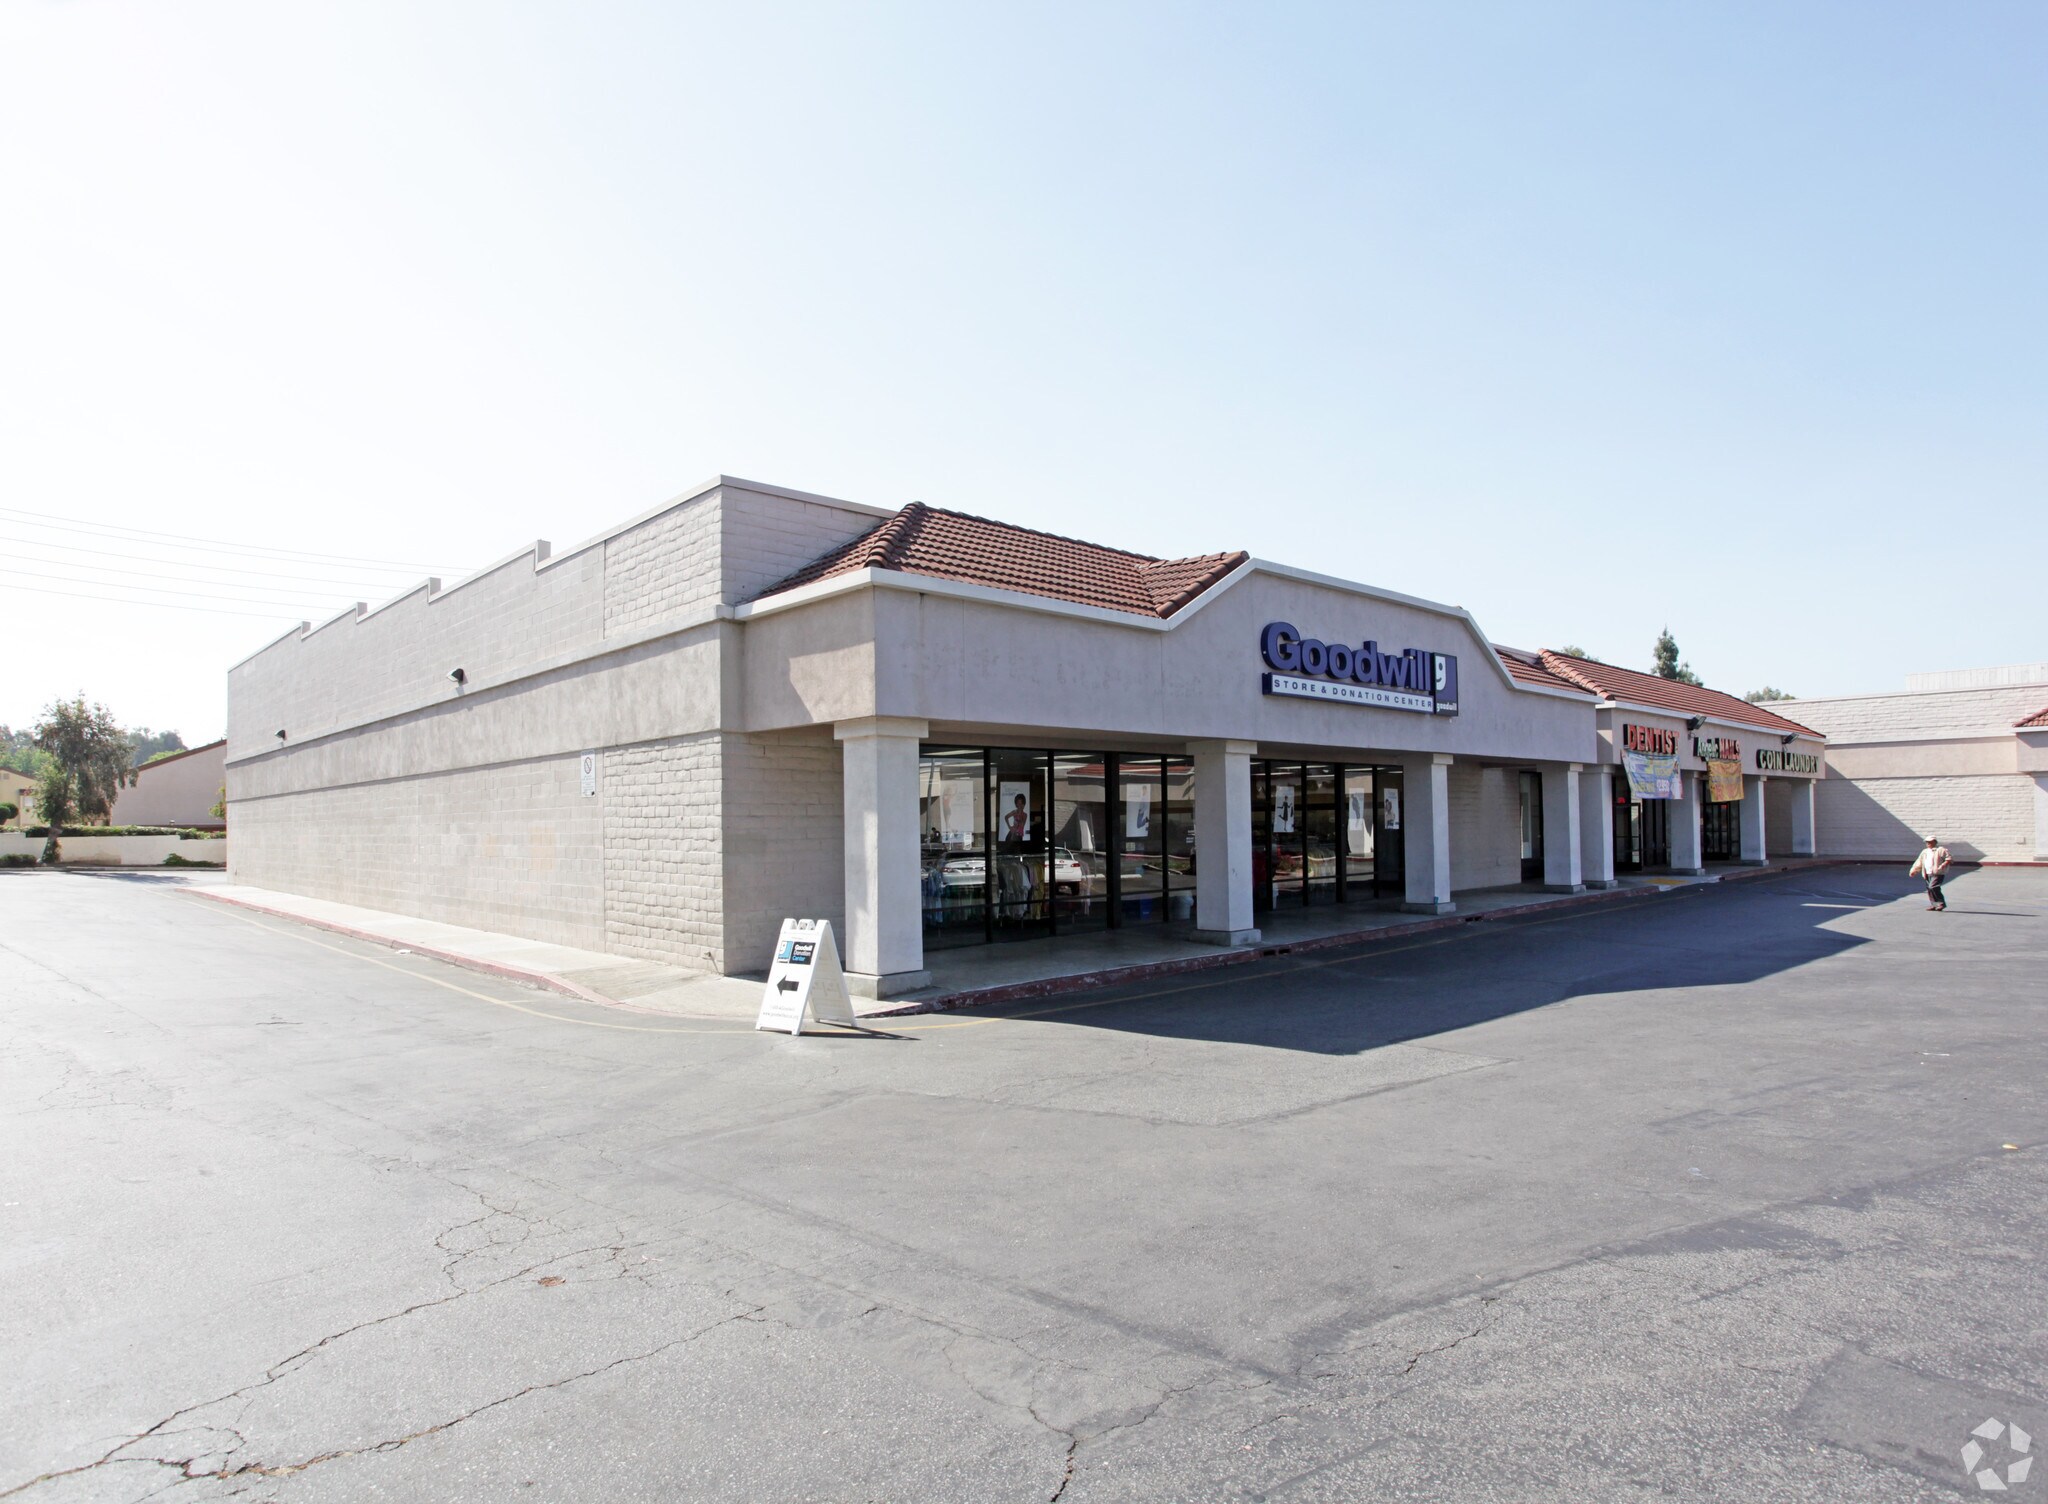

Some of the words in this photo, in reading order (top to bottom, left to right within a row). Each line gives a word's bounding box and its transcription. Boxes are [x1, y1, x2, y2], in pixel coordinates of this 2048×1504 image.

[1261, 621, 1432, 692] Goodwill
[1273, 679, 1316, 693] STORE
[1321, 685, 1328, 694] &
[1332, 687, 1391, 702] DONATION
[1393, 696, 1433, 708] CENTER
[1624, 723, 1680, 755] DENTIST
[1719, 738, 1741, 760] NAILS
[1758, 749, 1783, 770] COIN
[1784, 752, 1819, 774] LAUNDRY
